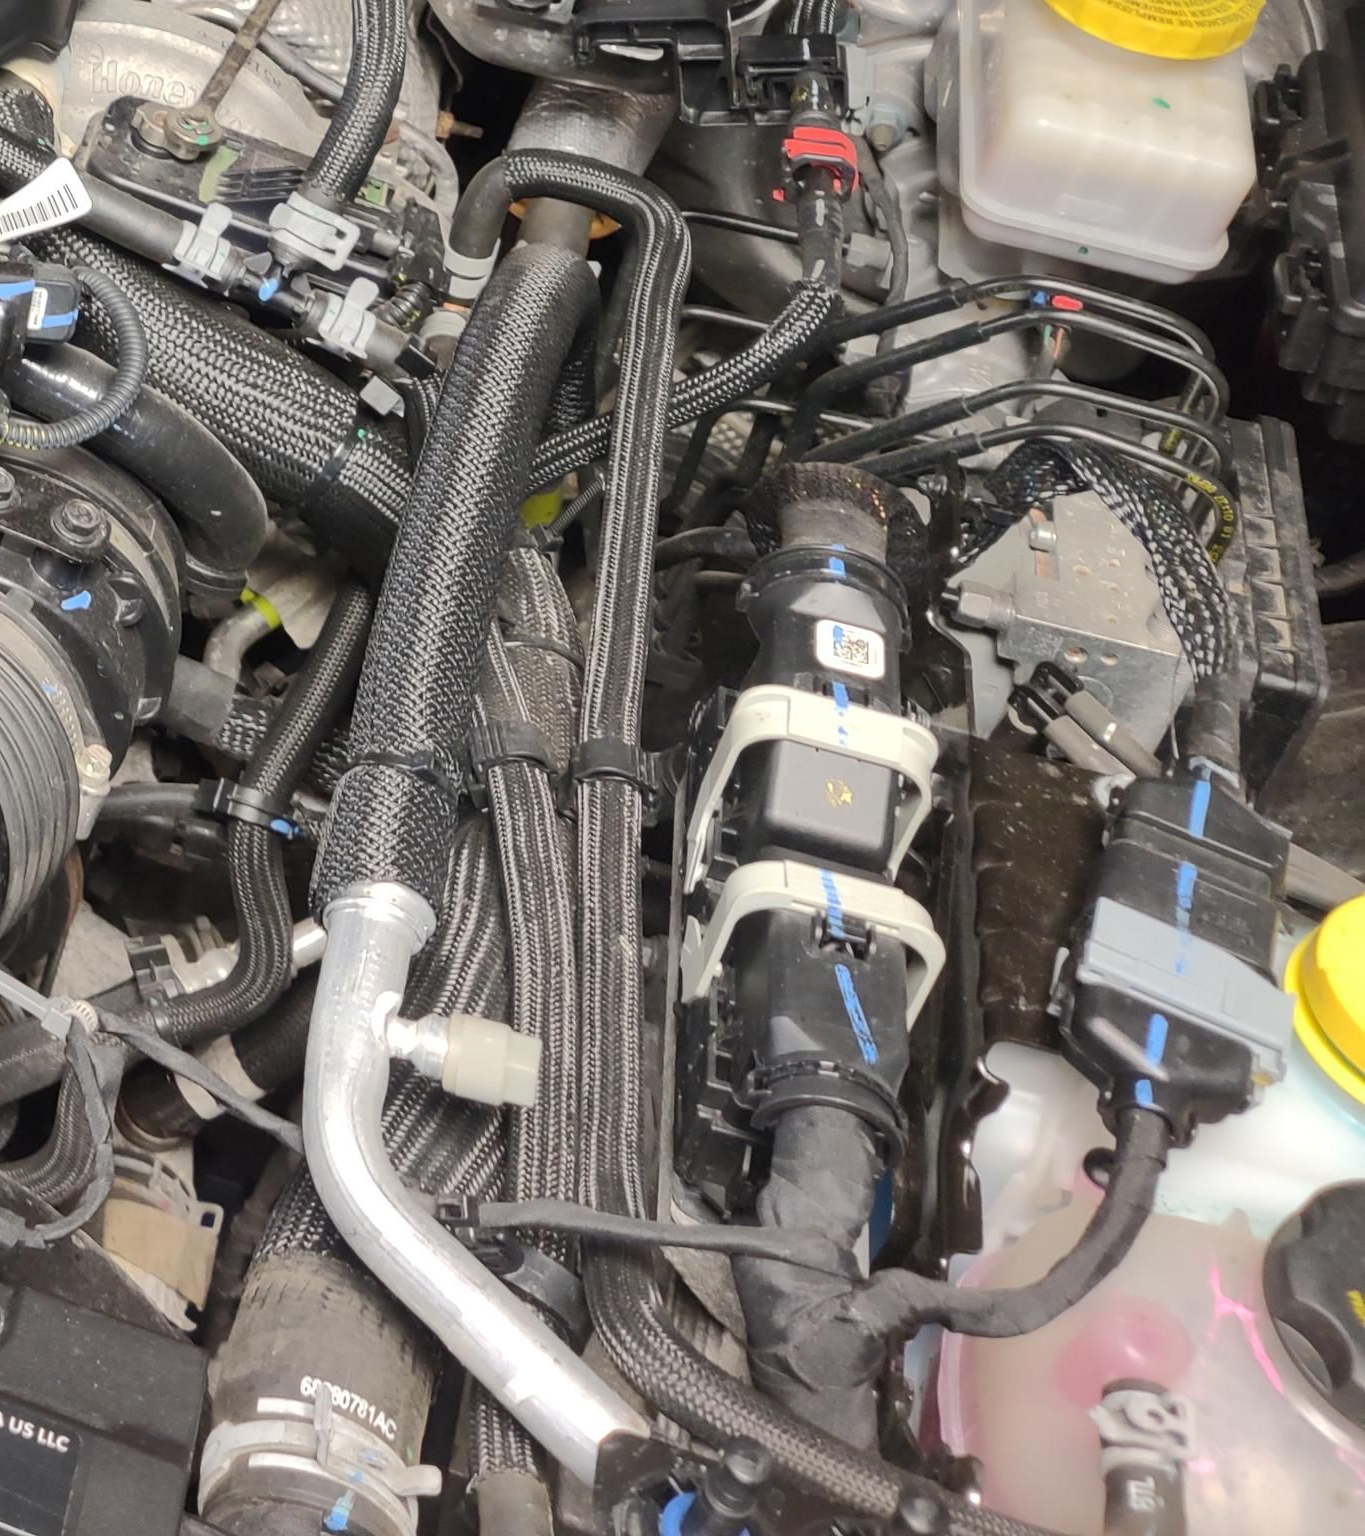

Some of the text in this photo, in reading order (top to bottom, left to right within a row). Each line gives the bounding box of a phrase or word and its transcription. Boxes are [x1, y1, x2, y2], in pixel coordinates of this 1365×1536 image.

[300, 1375, 398, 1441] 6880781AC
[7, 1416, 35, 1440] US
[37, 1426, 71, 1453] LLC
